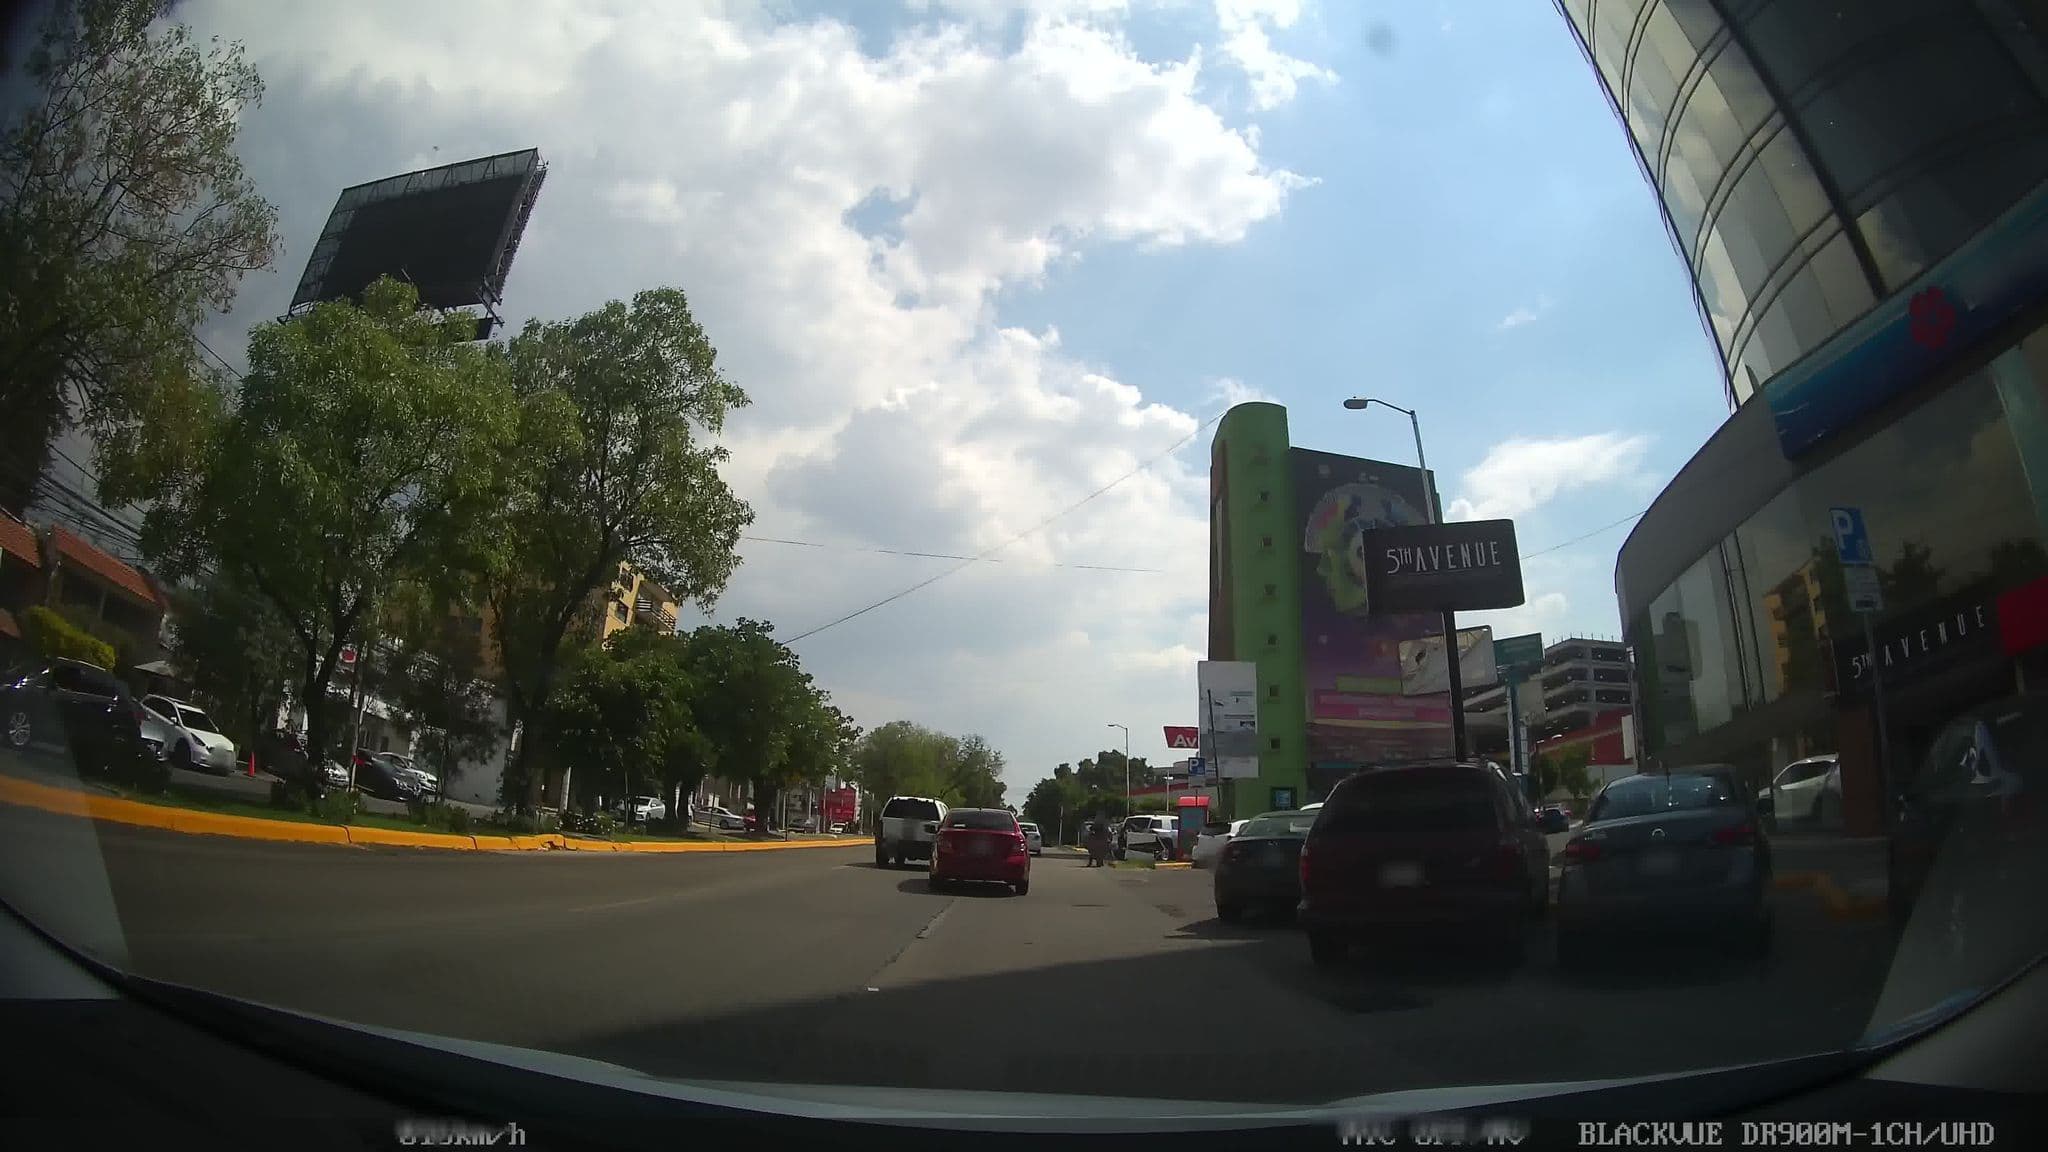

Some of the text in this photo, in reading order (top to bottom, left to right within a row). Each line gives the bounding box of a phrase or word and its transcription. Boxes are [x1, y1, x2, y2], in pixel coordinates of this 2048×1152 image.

[1830, 509, 1854, 551] P
[1386, 541, 1501, 574] 5TH AVENUE
[1852, 605, 1985, 679] 5TH AVENUE
[1189, 759, 1199, 771] P
